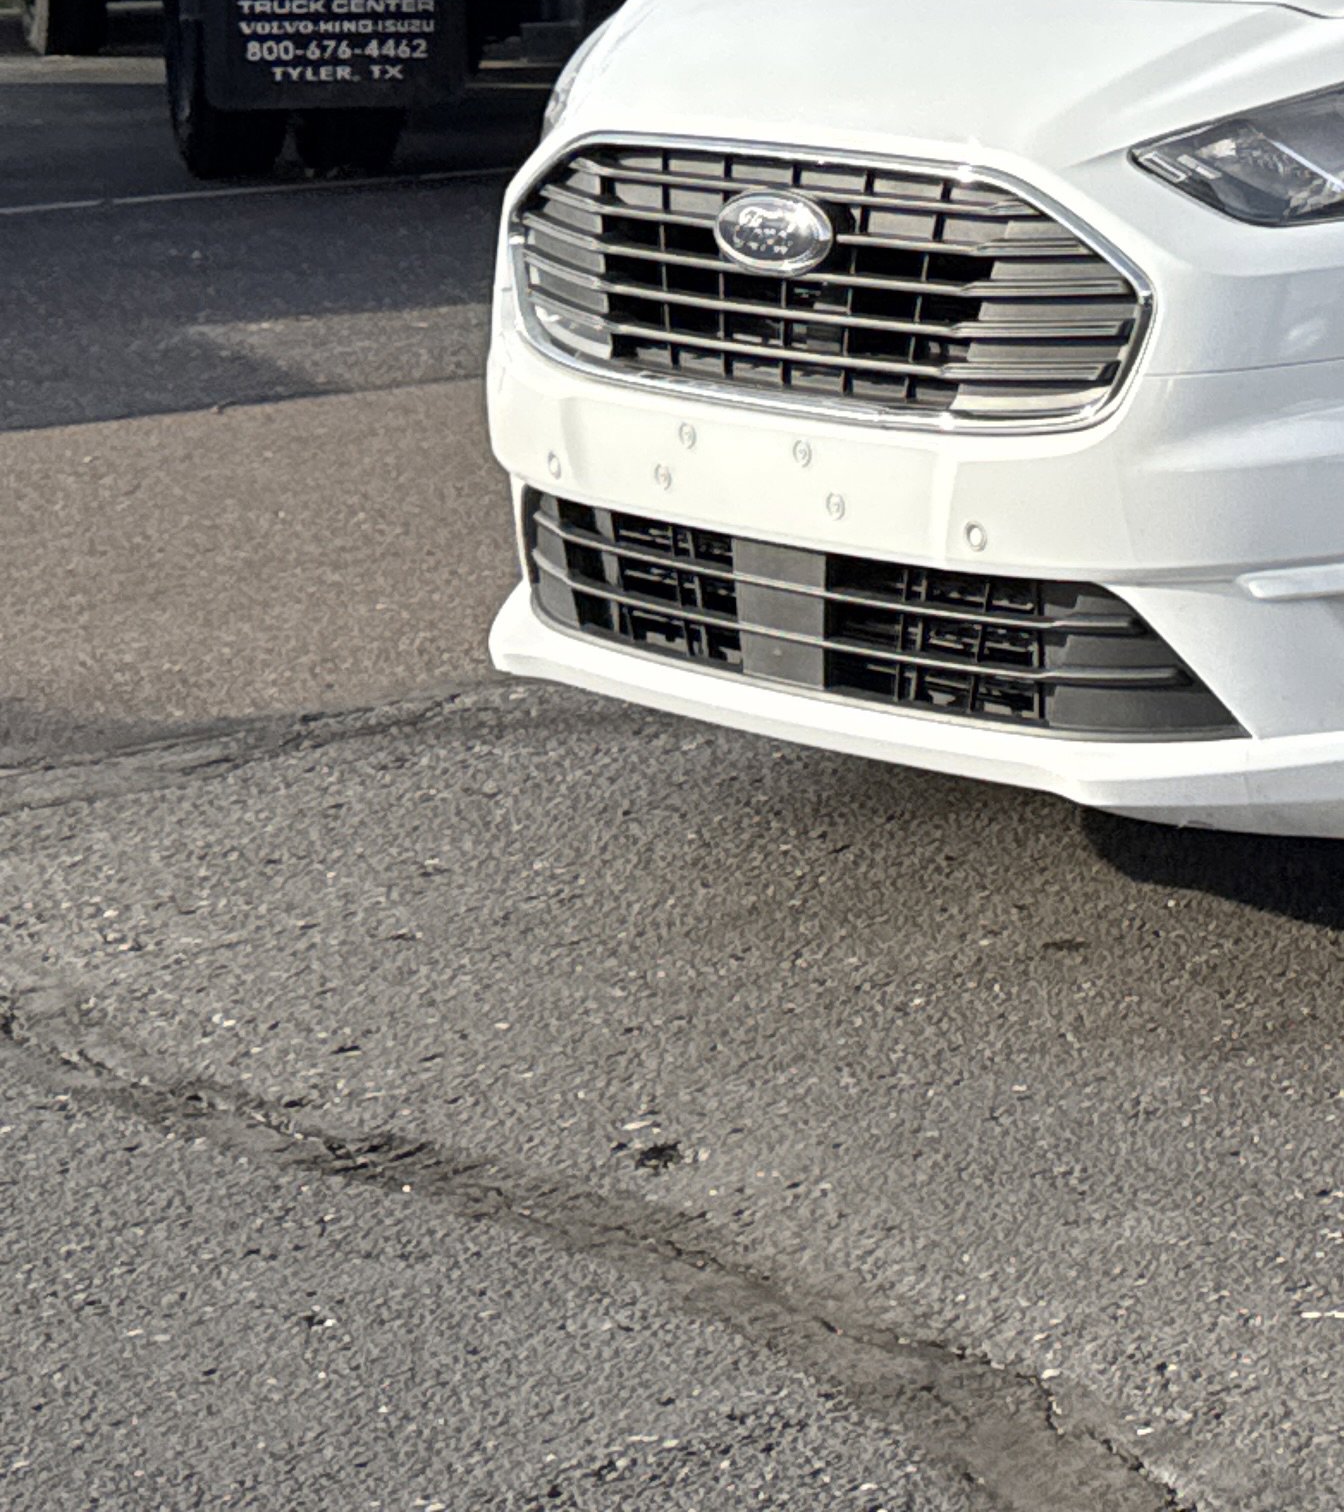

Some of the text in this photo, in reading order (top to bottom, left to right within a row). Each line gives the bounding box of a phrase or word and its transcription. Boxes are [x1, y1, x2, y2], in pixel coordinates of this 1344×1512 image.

[238, 0, 327, 14] TRUCK
[246, 39, 429, 61] 800-676-4462
[370, 64, 404, 80] TX
